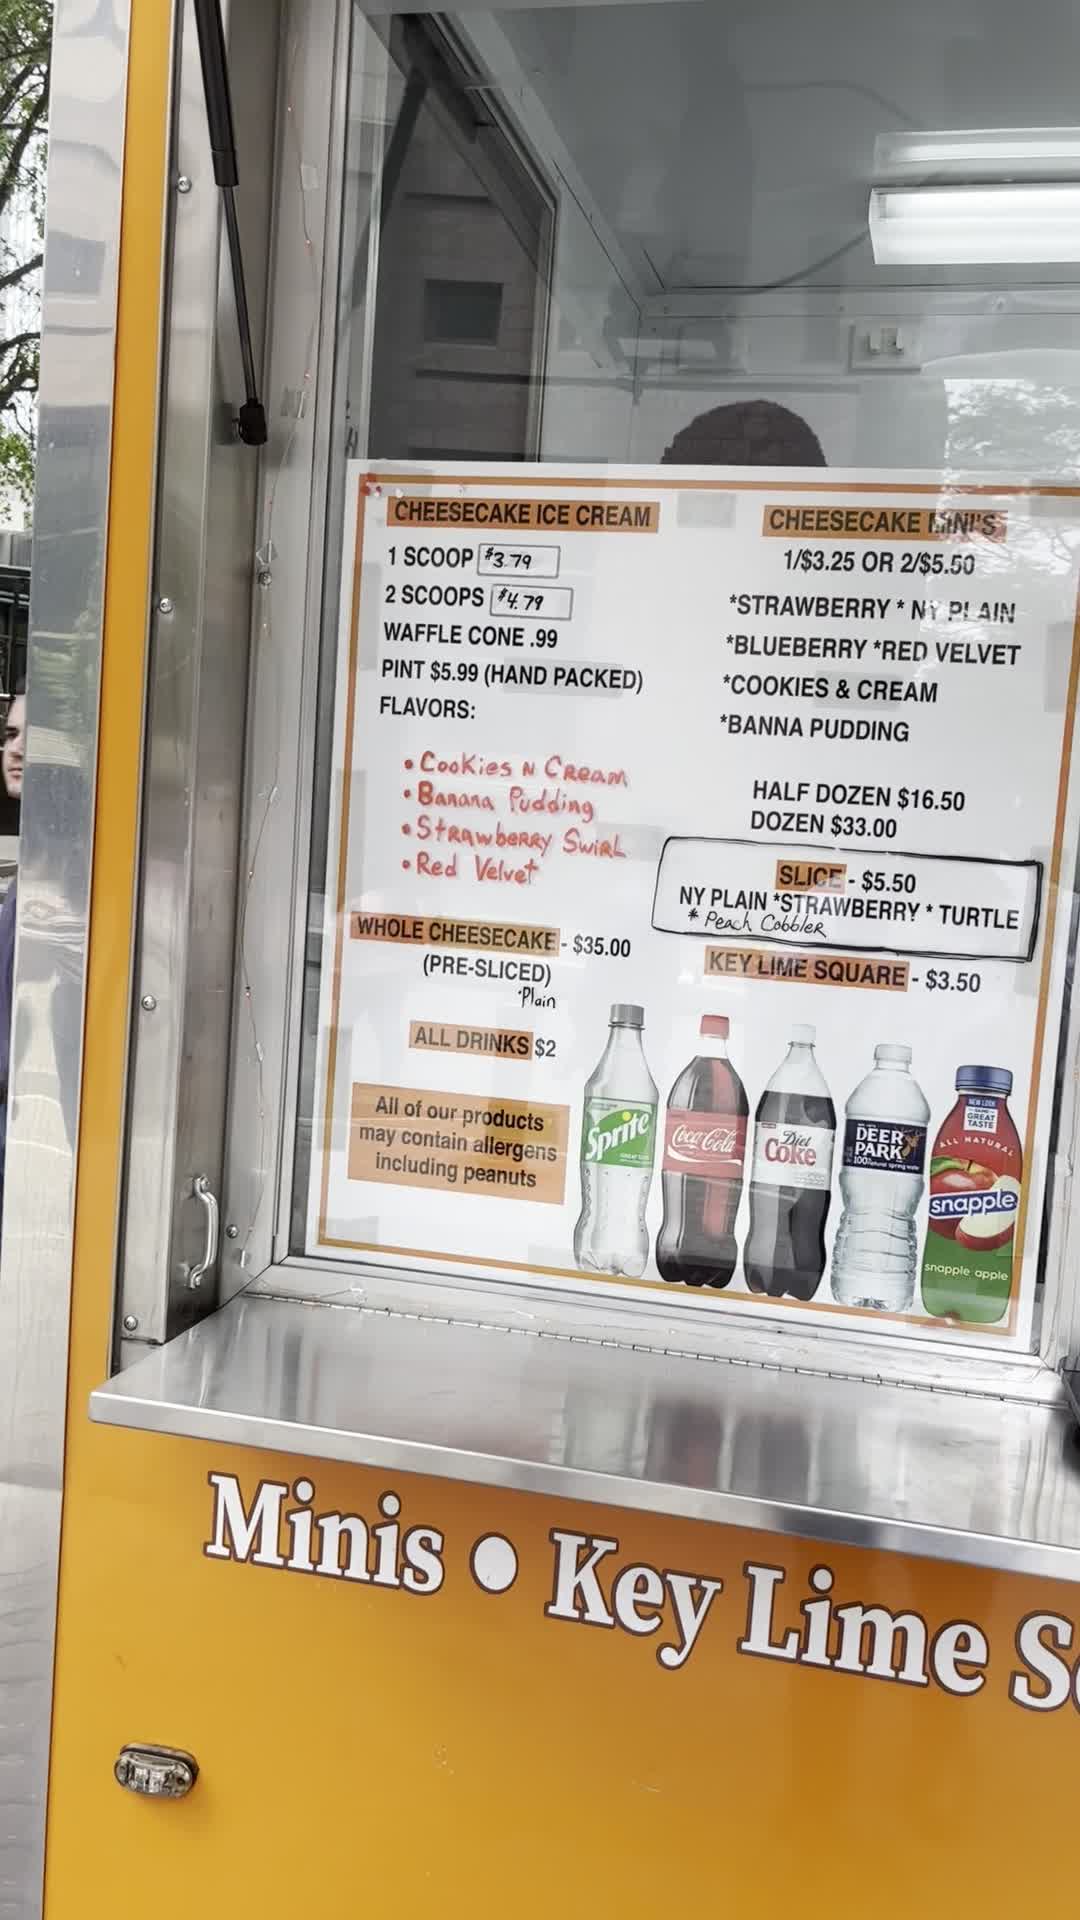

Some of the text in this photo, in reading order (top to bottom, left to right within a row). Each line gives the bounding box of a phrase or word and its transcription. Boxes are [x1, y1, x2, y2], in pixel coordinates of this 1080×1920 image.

[395, 500, 651, 527] CHEESECAKE ICE CREAM
[769, 509, 921, 534] CHEESECAKE
[388, 546, 474, 568] 1 SCOOP
[485, 547, 532, 570] $3.79
[784, 549, 976, 575] 1/$3.25 OR 2/$5.50
[385, 585, 485, 607] 2 SCOOPS
[498, 587, 545, 611] $4.79
[948, 601, 1016, 624] PLAIN
[384, 621, 558, 648] WAFFLE CONE .99
[935, 642, 1022, 665] VELVET
[382, 659, 644, 694] PINT $5.99 (HAND PACKED)
[835, 679, 850, 699] &
[857, 680, 938, 703] CREAM
[380, 696, 476, 719] FLAVORS:
[810, 718, 910, 742] PUDDING
[417, 780, 594, 824] Banana Pudding
[753, 780, 965, 811] HALF DOZEN $16.50
[751, 810, 897, 838] DOZEN $33.00
[416, 851, 539, 884] Red Velvet
[779, 863, 843, 889] SLICE
[861, 870, 916, 893] $5.50
[679, 886, 706, 907] NY
[710, 888, 767, 911] PLAIN
[939, 905, 1019, 930] TURTLE
[705, 910, 752, 932] Peach
[357, 916, 423, 940] WHOLE
[429, 922, 557, 951] CHEESECAKE
[573, 934, 631, 958] $35.00
[423, 953, 552, 987] (PRE-SLICED)
[709, 950, 753, 974] KEY
[757, 954, 807, 977] LIME
[814, 958, 906, 987] SQUARE
[925, 969, 980, 993] $3.50
[414, 1026, 557, 1058] ALL DRINKS $2
[376, 1095, 545, 1132] All of our products
[967, 1112, 995, 1121] GREAT
[967, 1119, 994, 1129] TASTE
[359, 1126, 557, 1163] may contain allergens
[585, 1113, 650, 1161] Sprite
[782, 1130, 812, 1147] Diet
[856, 1126, 904, 1145] DEER
[940, 1136, 1015, 1157] ALL NATURAL
[765, 1138, 816, 1167] Coke
[855, 1141, 904, 1161] PARK
[375, 1152, 537, 1188] including peanuts
[931, 1189, 1016, 1216] snapple
[925, 1263, 1009, 1281] snapple apple
[204, 1471, 1080, 1714] Minis Key Lime S
